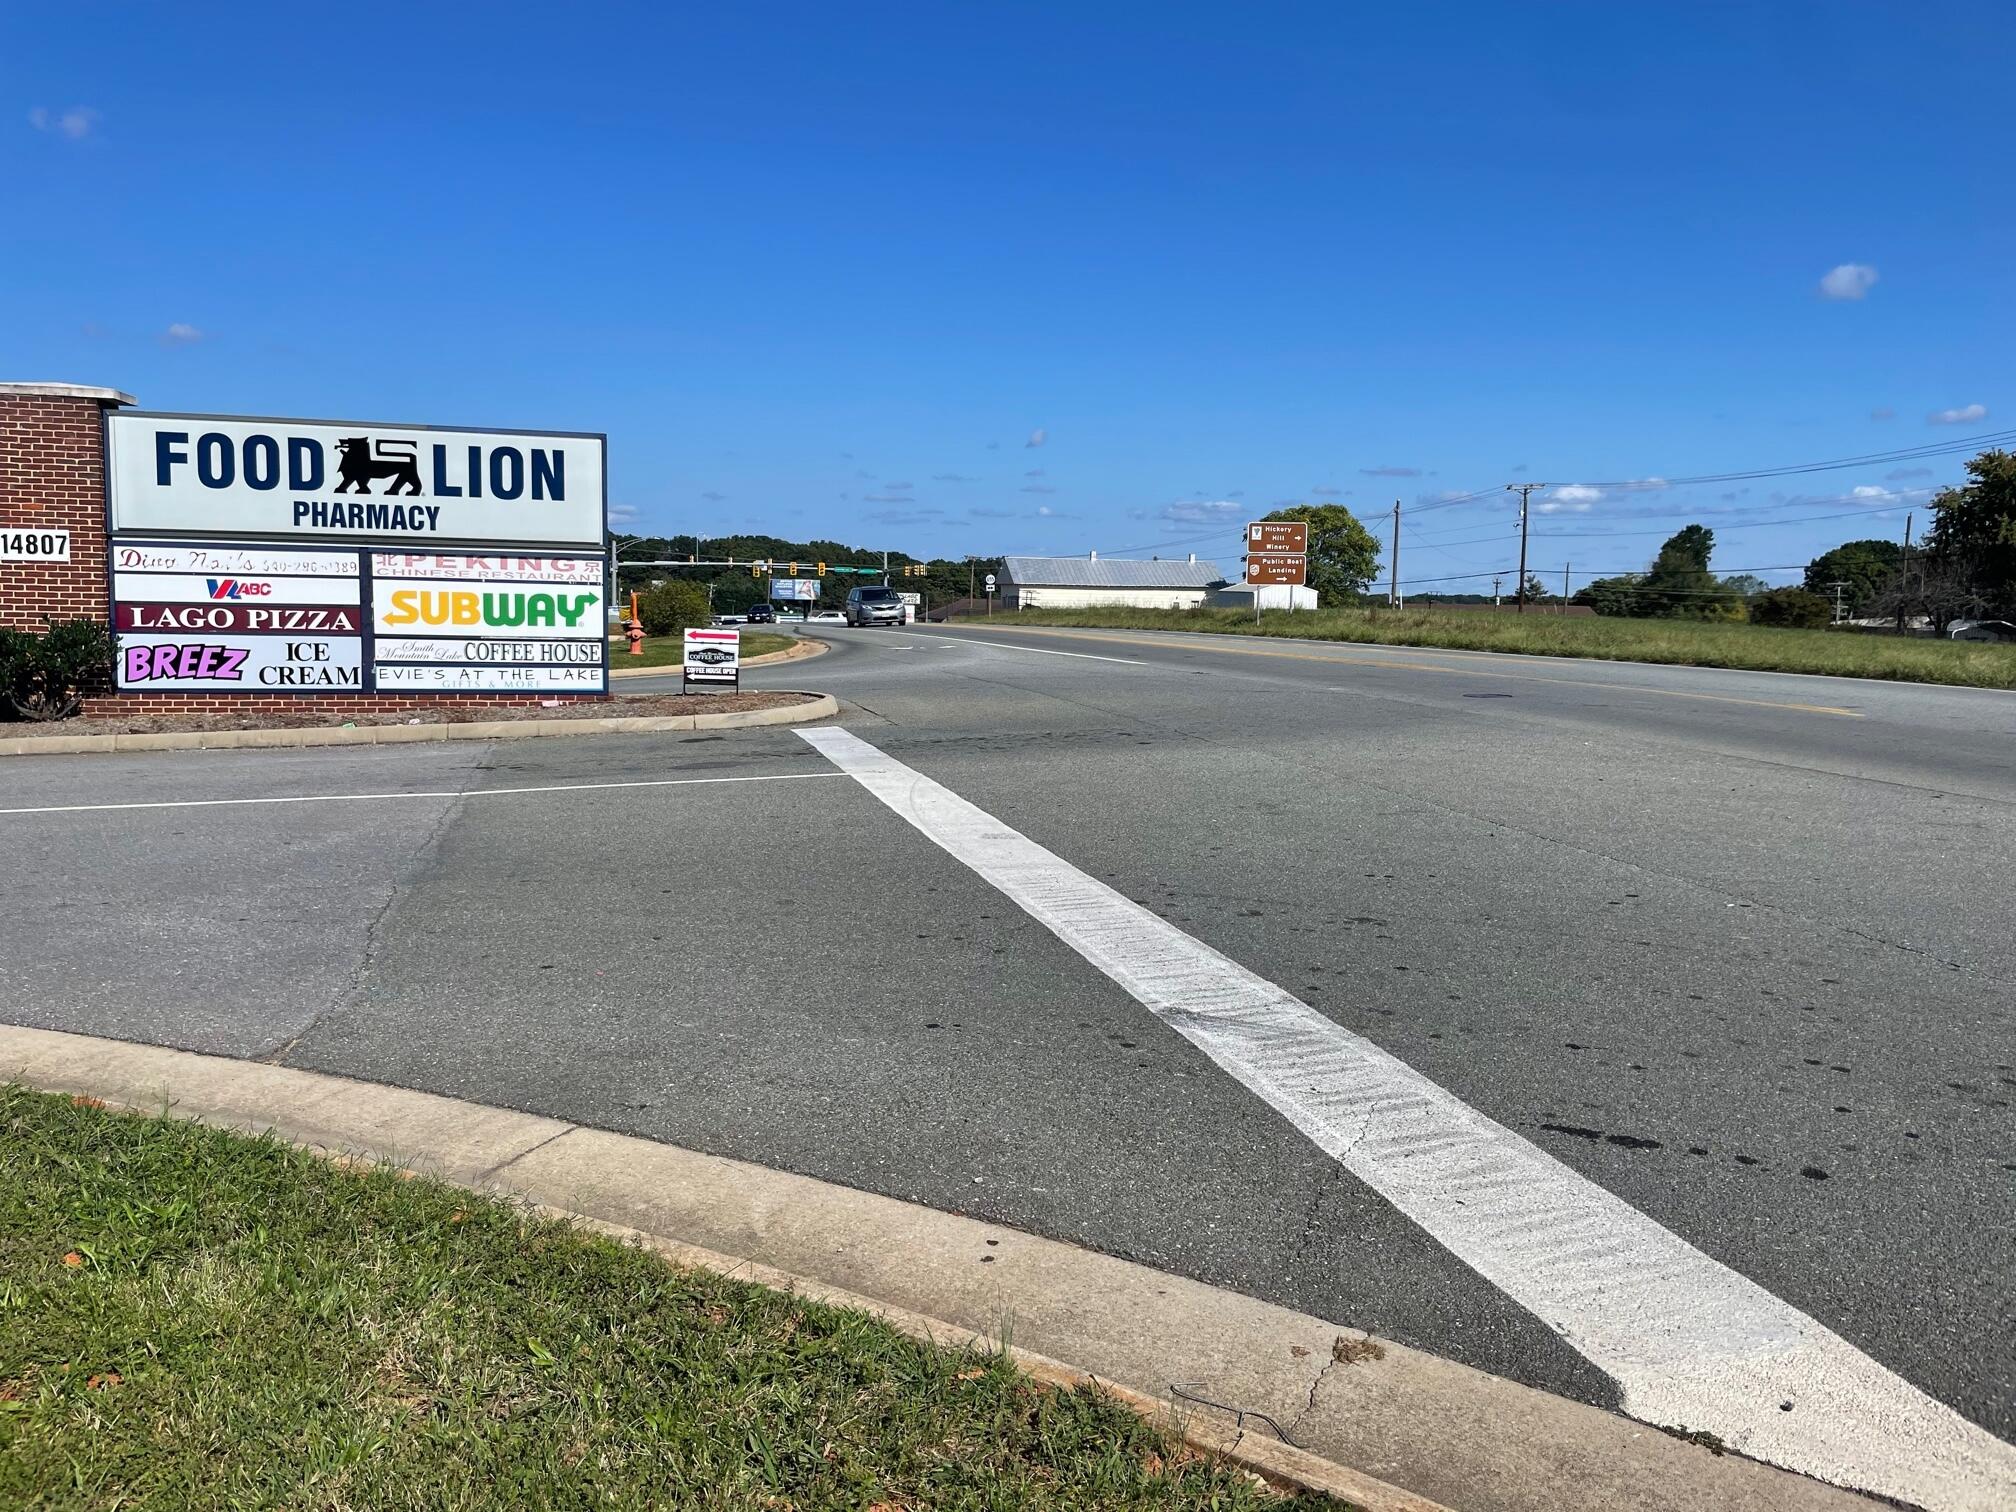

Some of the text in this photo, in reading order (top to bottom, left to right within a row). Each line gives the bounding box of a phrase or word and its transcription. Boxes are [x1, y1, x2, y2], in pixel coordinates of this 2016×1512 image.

[155, 430, 566, 501] FOOD LION
[293, 500, 440, 532] PHARMACY
[1, 533, 67, 555] 14807
[404, 554, 576, 573] PEKING
[1268, 567, 1296, 575] Landing
[376, 568, 602, 582] CHINESE RESTAURANT
[382, 590, 599, 627] SUBWAY
[130, 607, 354, 631] LAGO PIZZA
[286, 642, 330, 662] ICE
[402, 641, 434, 652] Smith
[464, 641, 601, 662] COFFEE HOUSE
[125, 644, 251, 682] BREEZ
[259, 666, 360, 685] CREAM
[379, 669, 600, 681] EVIE'S AT THE LAKE
[442, 680, 481, 689] GIFTS
[504, 681, 541, 689] MORE
